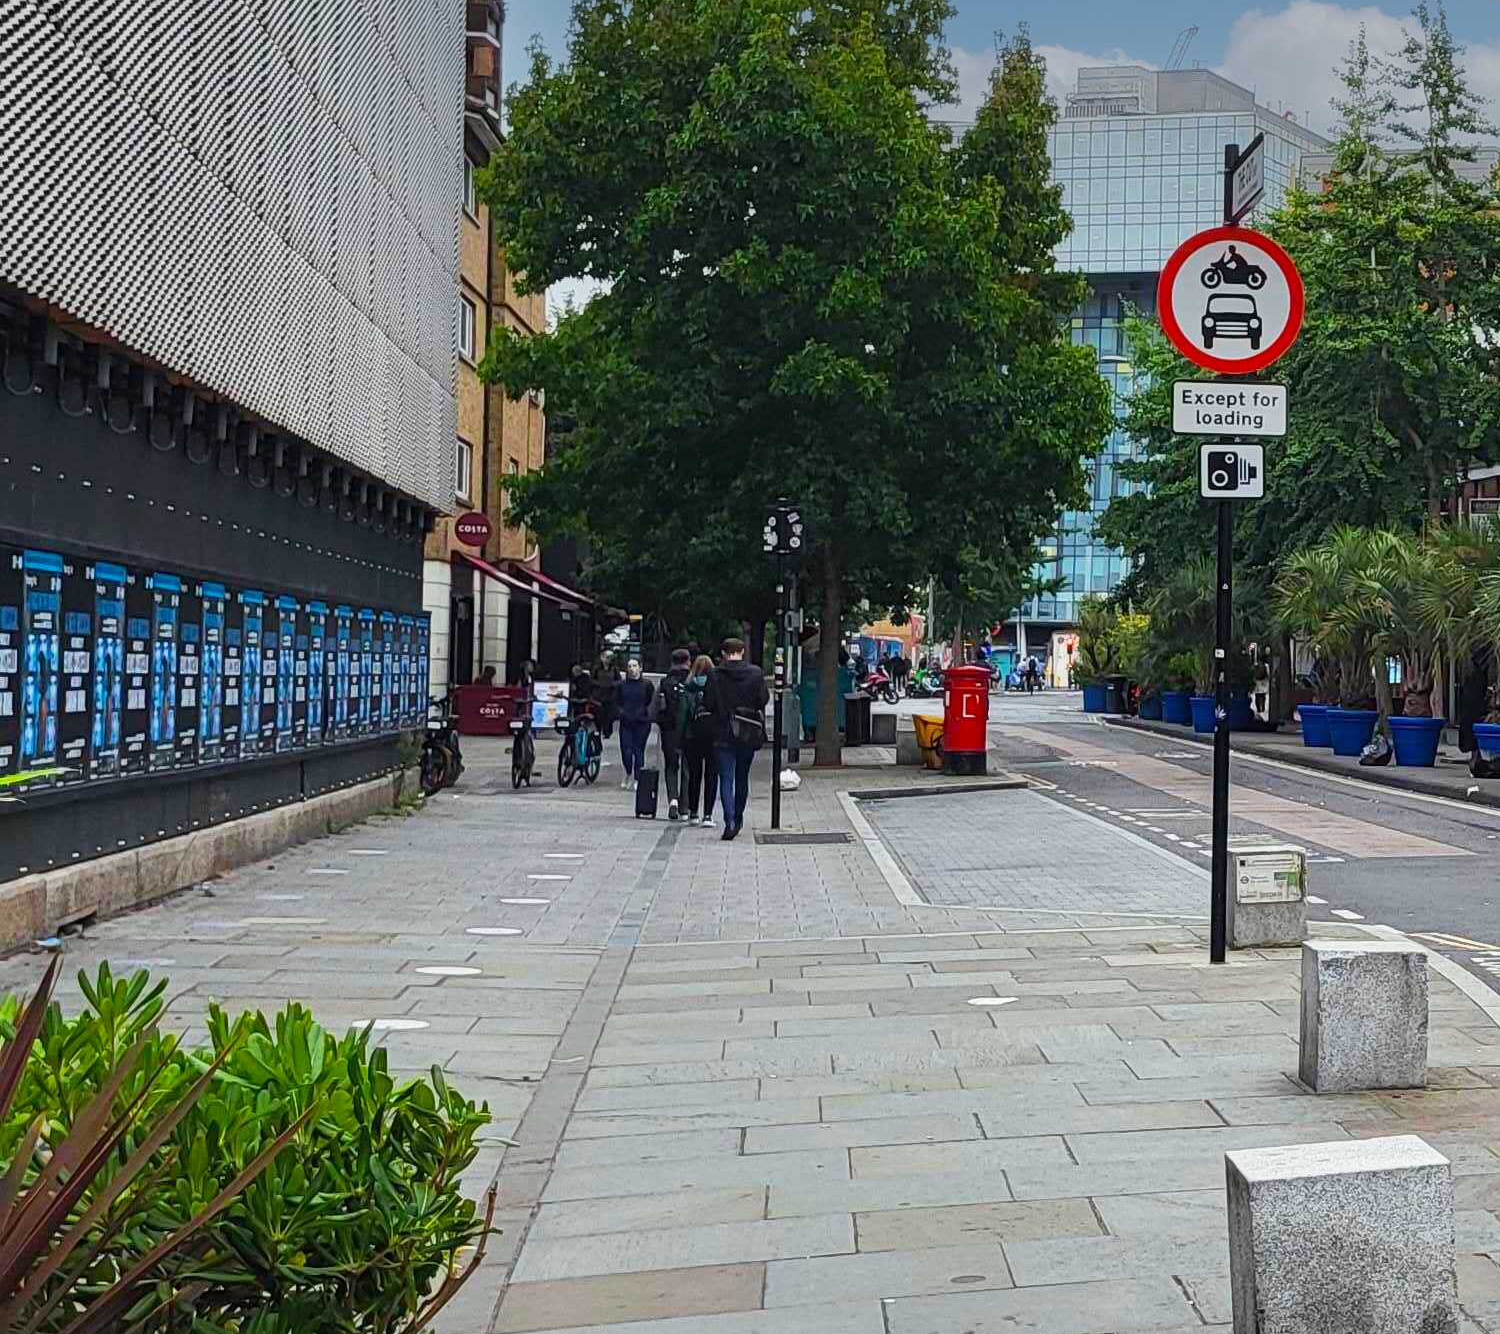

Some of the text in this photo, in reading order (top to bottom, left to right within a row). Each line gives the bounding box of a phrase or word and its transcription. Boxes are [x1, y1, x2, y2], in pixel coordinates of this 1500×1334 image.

[1182, 389, 1279, 408] Except for
[1196, 409, 1264, 429] loading
[458, 524, 488, 534] COSTA
[479, 707, 505, 716] COSTA
